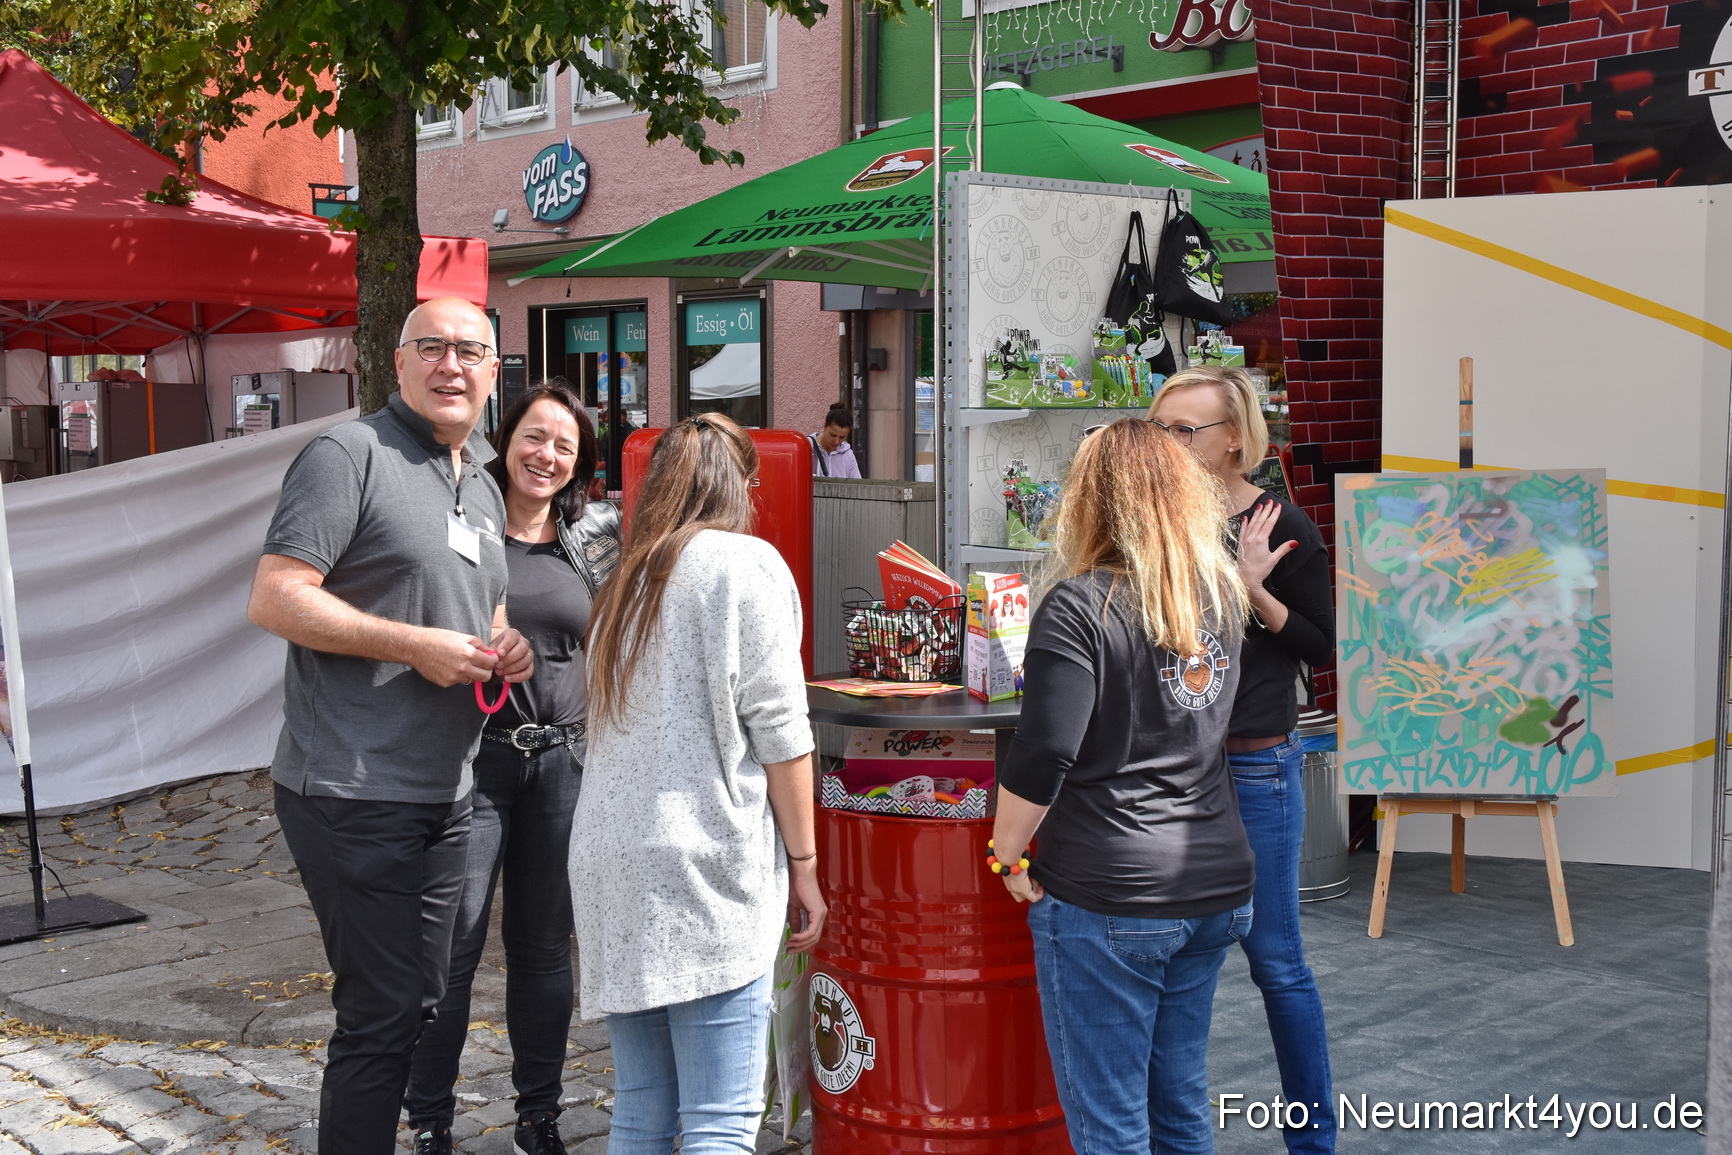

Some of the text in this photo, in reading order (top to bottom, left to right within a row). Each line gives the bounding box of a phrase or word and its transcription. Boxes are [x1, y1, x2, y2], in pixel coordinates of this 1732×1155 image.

[1695, 69, 1725, 92] T
[522, 152, 556, 191] vom
[532, 161, 587, 219] FASS
[573, 324, 600, 342] Wein
[695, 307, 754, 337] Essig Öl
[1009, 328, 1031, 341] POWER
[891, 572, 913, 583] HERZLICH
[912, 577, 943, 600] WILLKOMMEN
[884, 736, 946, 752] POWER
